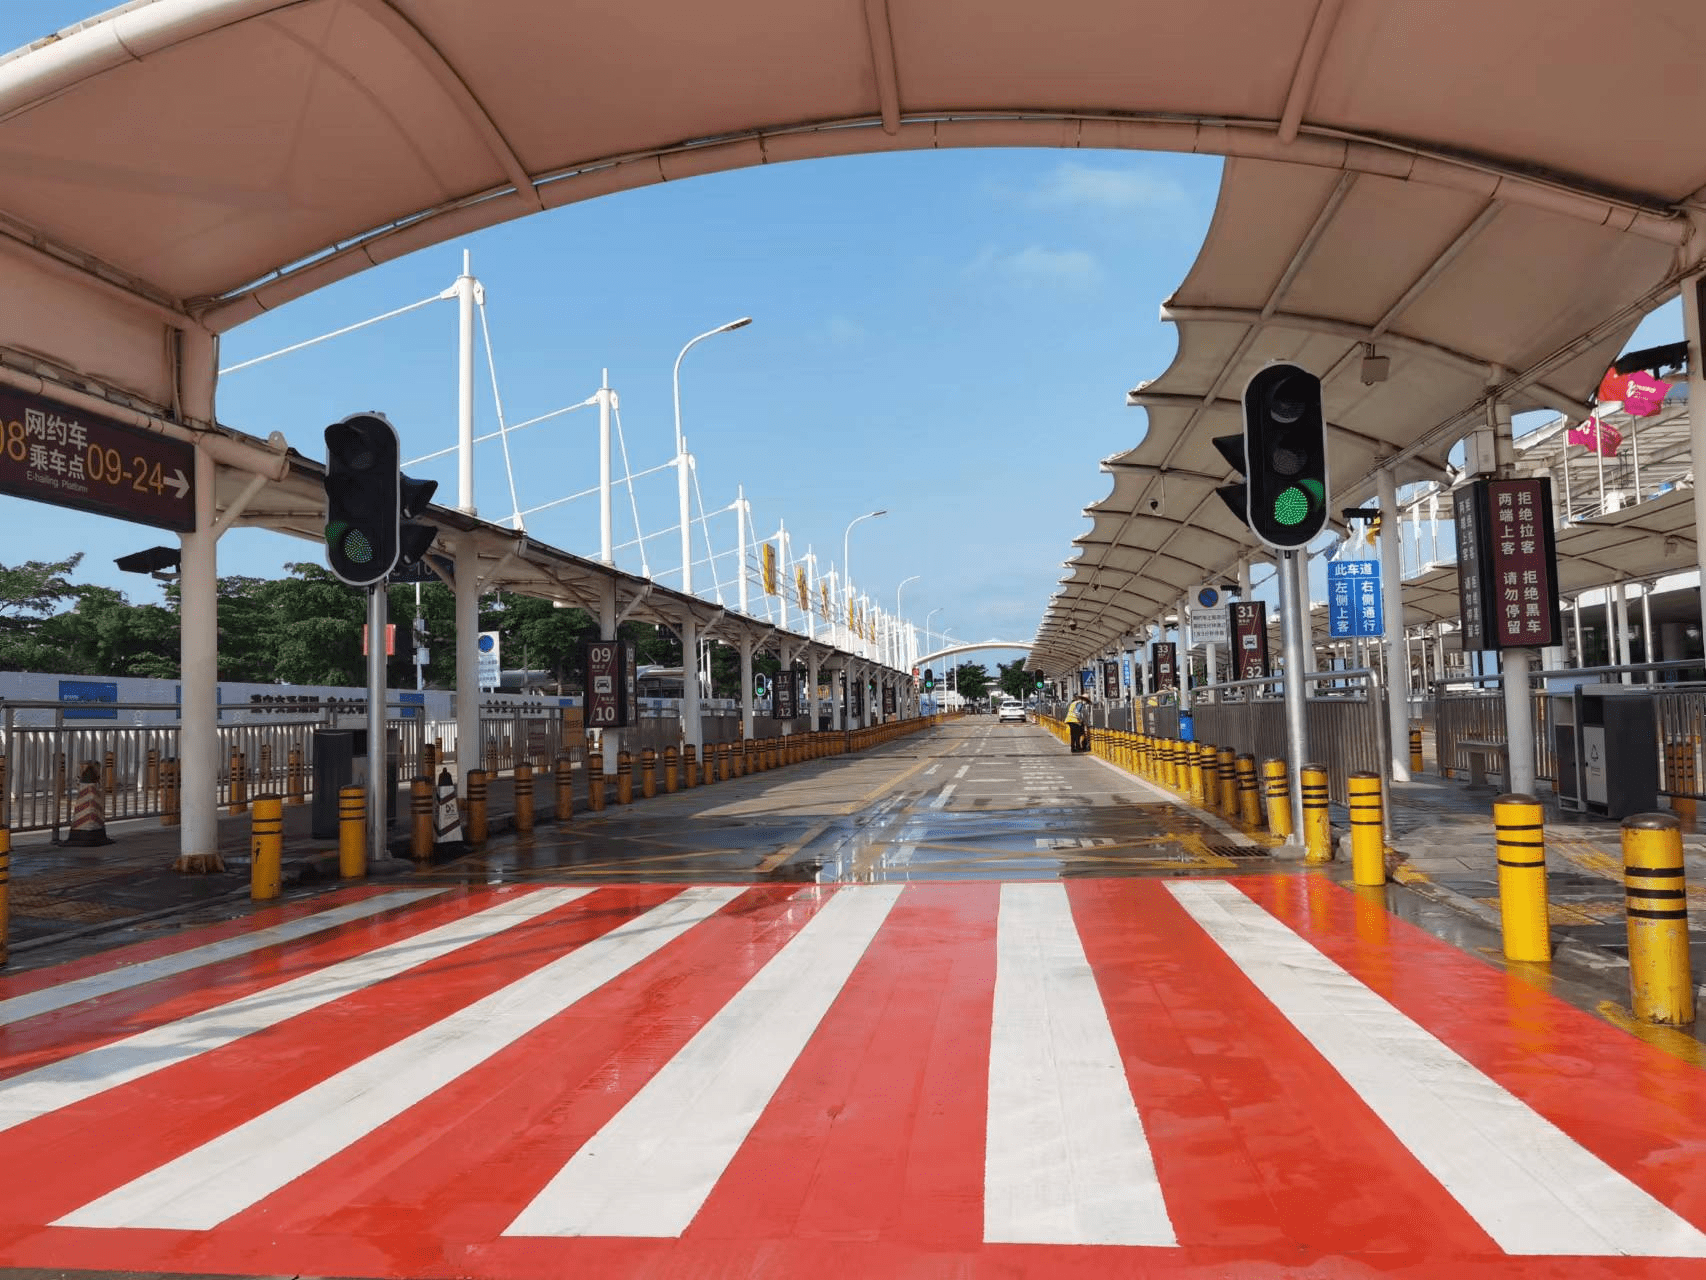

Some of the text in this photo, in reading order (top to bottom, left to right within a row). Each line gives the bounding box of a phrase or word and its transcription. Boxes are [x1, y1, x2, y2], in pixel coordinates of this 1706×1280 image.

[25, 408, 88, 451] 网约车
[30, 444, 86, 480] 乘车点
[87, 443, 164, 495] 09-24
[1335, 563, 1373, 576] 此车道
[1498, 492, 1521, 635] 两端上客 请勿停留
[1518, 491, 1542, 634] 拒绝拉客 拒绝黑车
[1238, 605, 1254, 618] 31
[1335, 581, 1349, 632] 左侧上客
[1361, 580, 1376, 632] 右侧通行
[591, 648, 611, 662] 09
[1246, 666, 1263, 678] 32
[595, 706, 615, 721] 10
